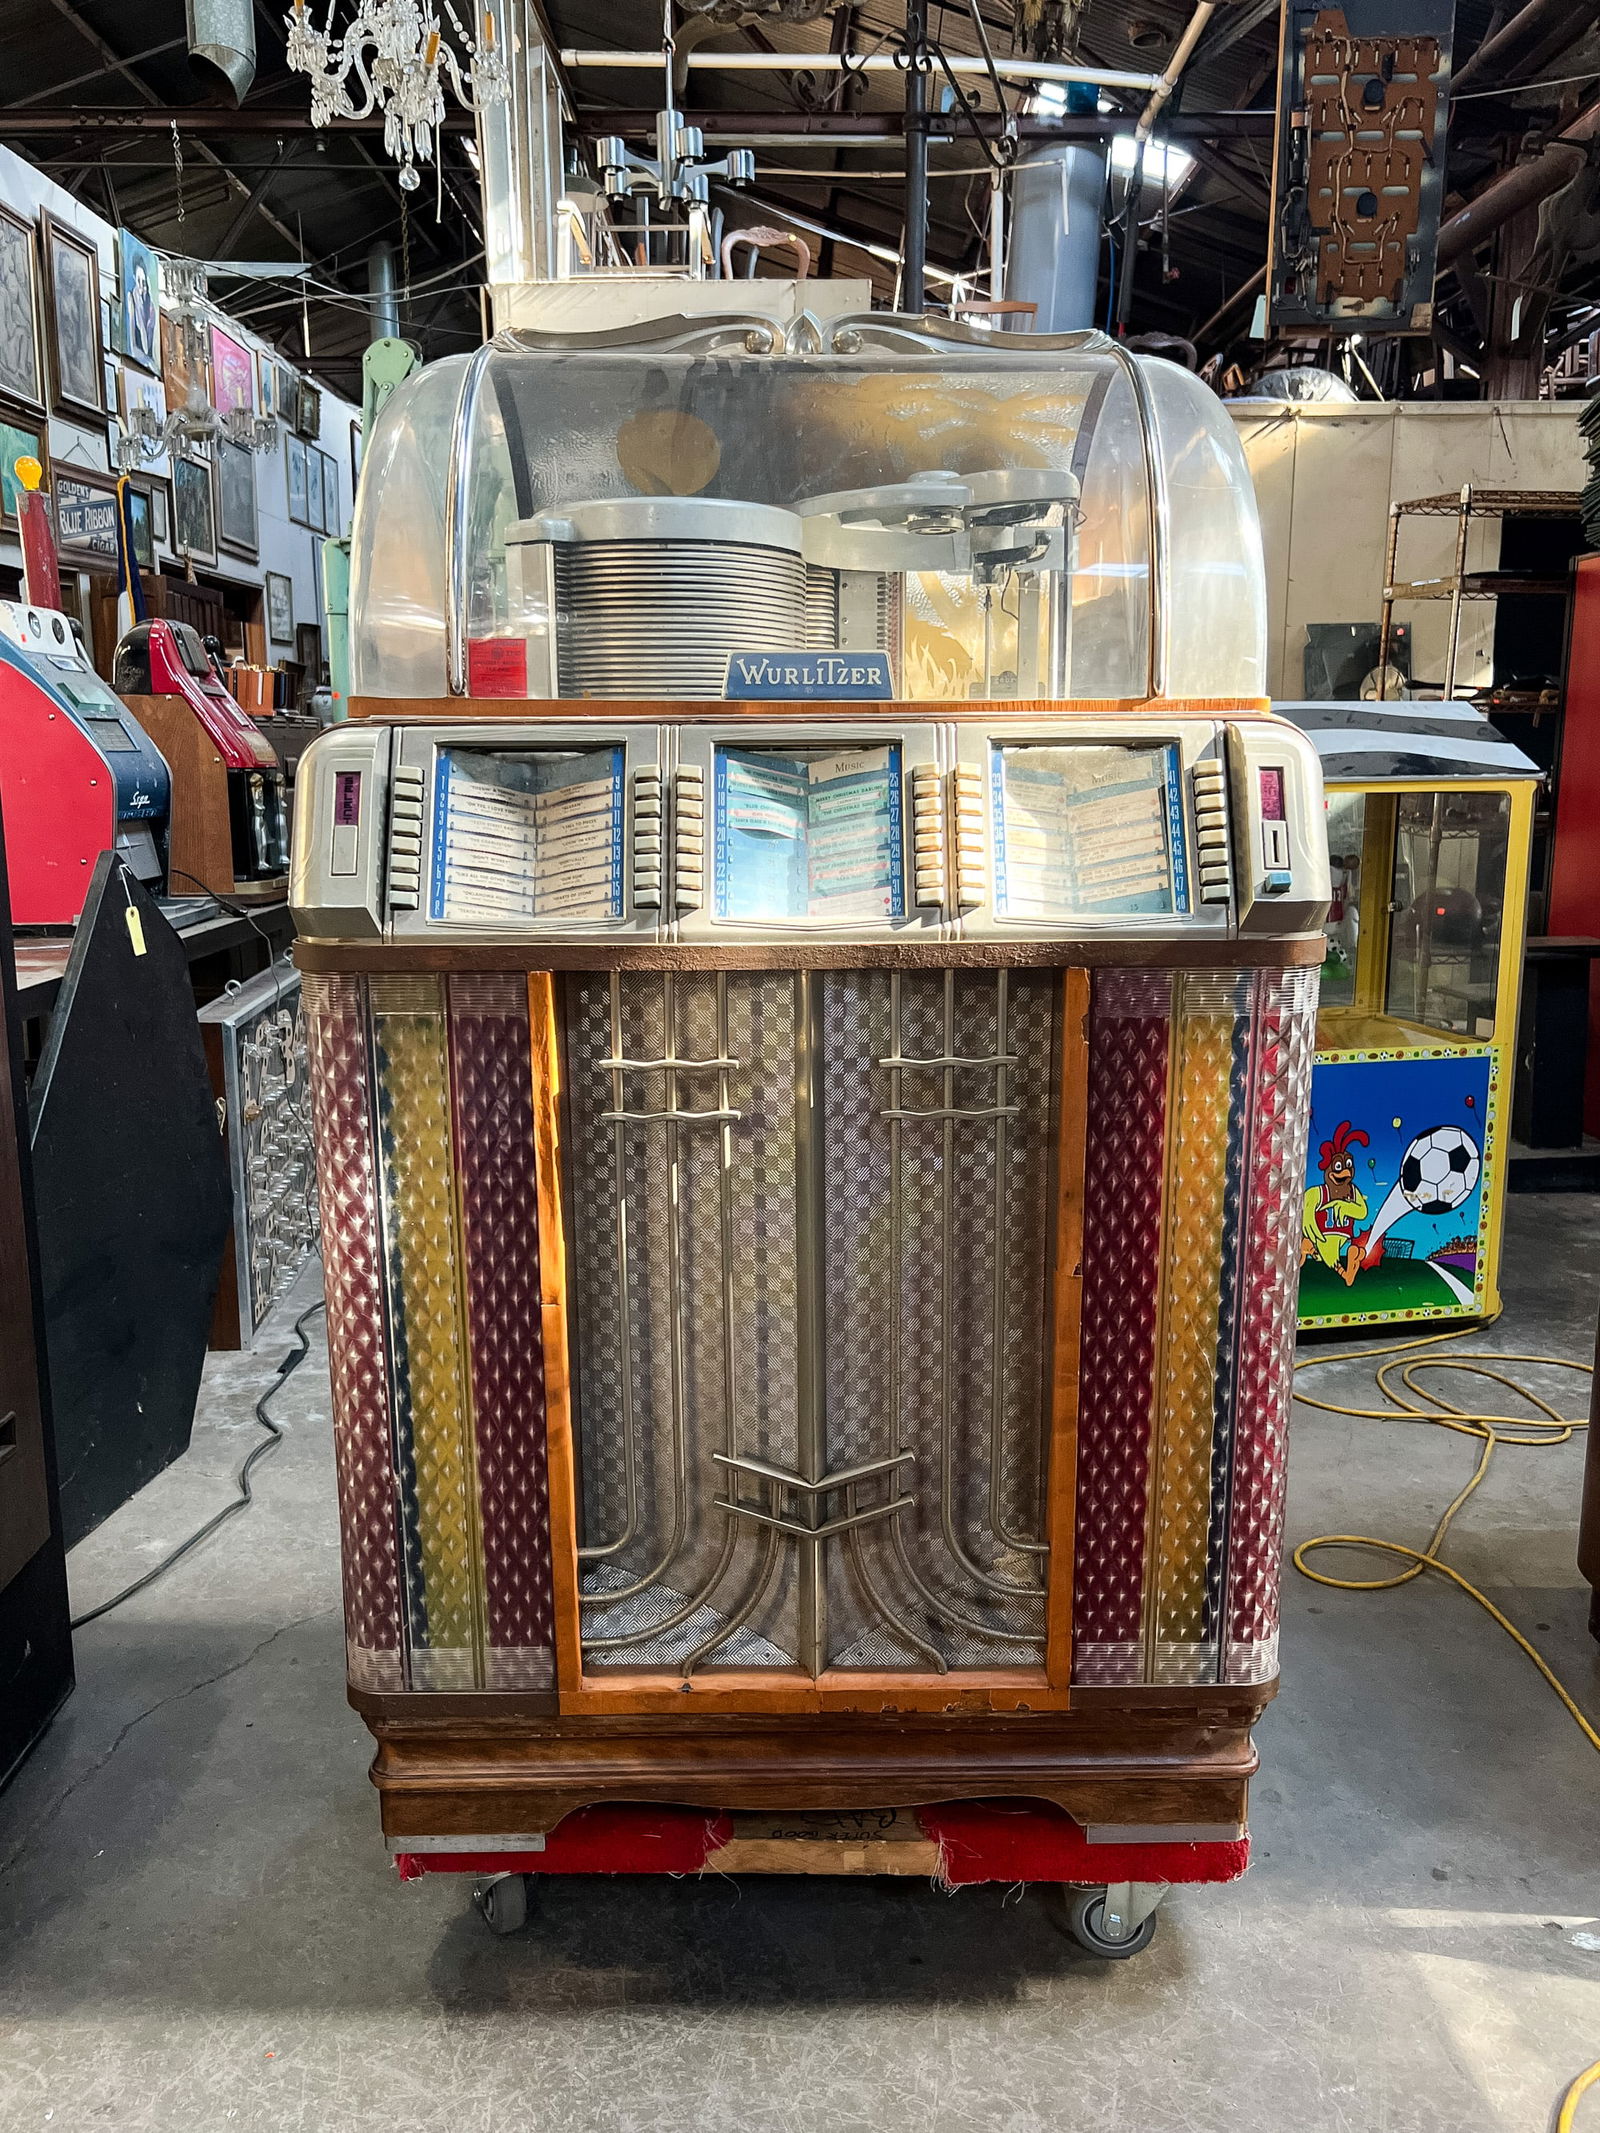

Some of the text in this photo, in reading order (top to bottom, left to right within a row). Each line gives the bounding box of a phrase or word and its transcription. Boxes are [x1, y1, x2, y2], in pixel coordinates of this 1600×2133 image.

[60, 506, 114, 534] BLUE RIBBON
[92, 540, 114, 553] CIGAR
[736, 658, 882, 685] WURLITZER
[441, 776, 446, 790] 1
[615, 776, 620, 790] 9
[718, 774, 725, 789] 17
[890, 773, 899, 787] 25
[992, 773, 1001, 787] 33
[1168, 770, 1176, 784] 41
[440, 792, 445, 808] 2
[614, 792, 621, 807] 10
[718, 792, 725, 806] 18
[890, 790, 899, 805] 26
[993, 792, 1002, 806] 34
[1169, 788, 1178, 802] 42
[438, 810, 444, 825] 3
[614, 810, 620, 824] 11
[718, 809, 725, 824] 19
[890, 808, 899, 822] 27
[1170, 806, 1179, 820] 43
[438, 828, 442, 843] 4
[613, 828, 620, 842] 12
[717, 827, 725, 841] 20
[891, 826, 899, 840] 28
[1172, 823, 1180, 837] 44
[437, 846, 442, 860] 5
[613, 846, 620, 860] 13
[717, 845, 725, 859] 21
[891, 844, 900, 858] 29
[1173, 841, 1181, 855] 45
[436, 864, 441, 879] 6
[613, 864, 620, 878] 14
[717, 863, 726, 877] 22
[892, 862, 900, 876] 30
[1174, 859, 1183, 873] 46
[436, 882, 440, 896] 7
[613, 881, 620, 896] 15
[716, 881, 725, 896] 23
[892, 879, 900, 894] 31
[1175, 877, 1183, 891] 47
